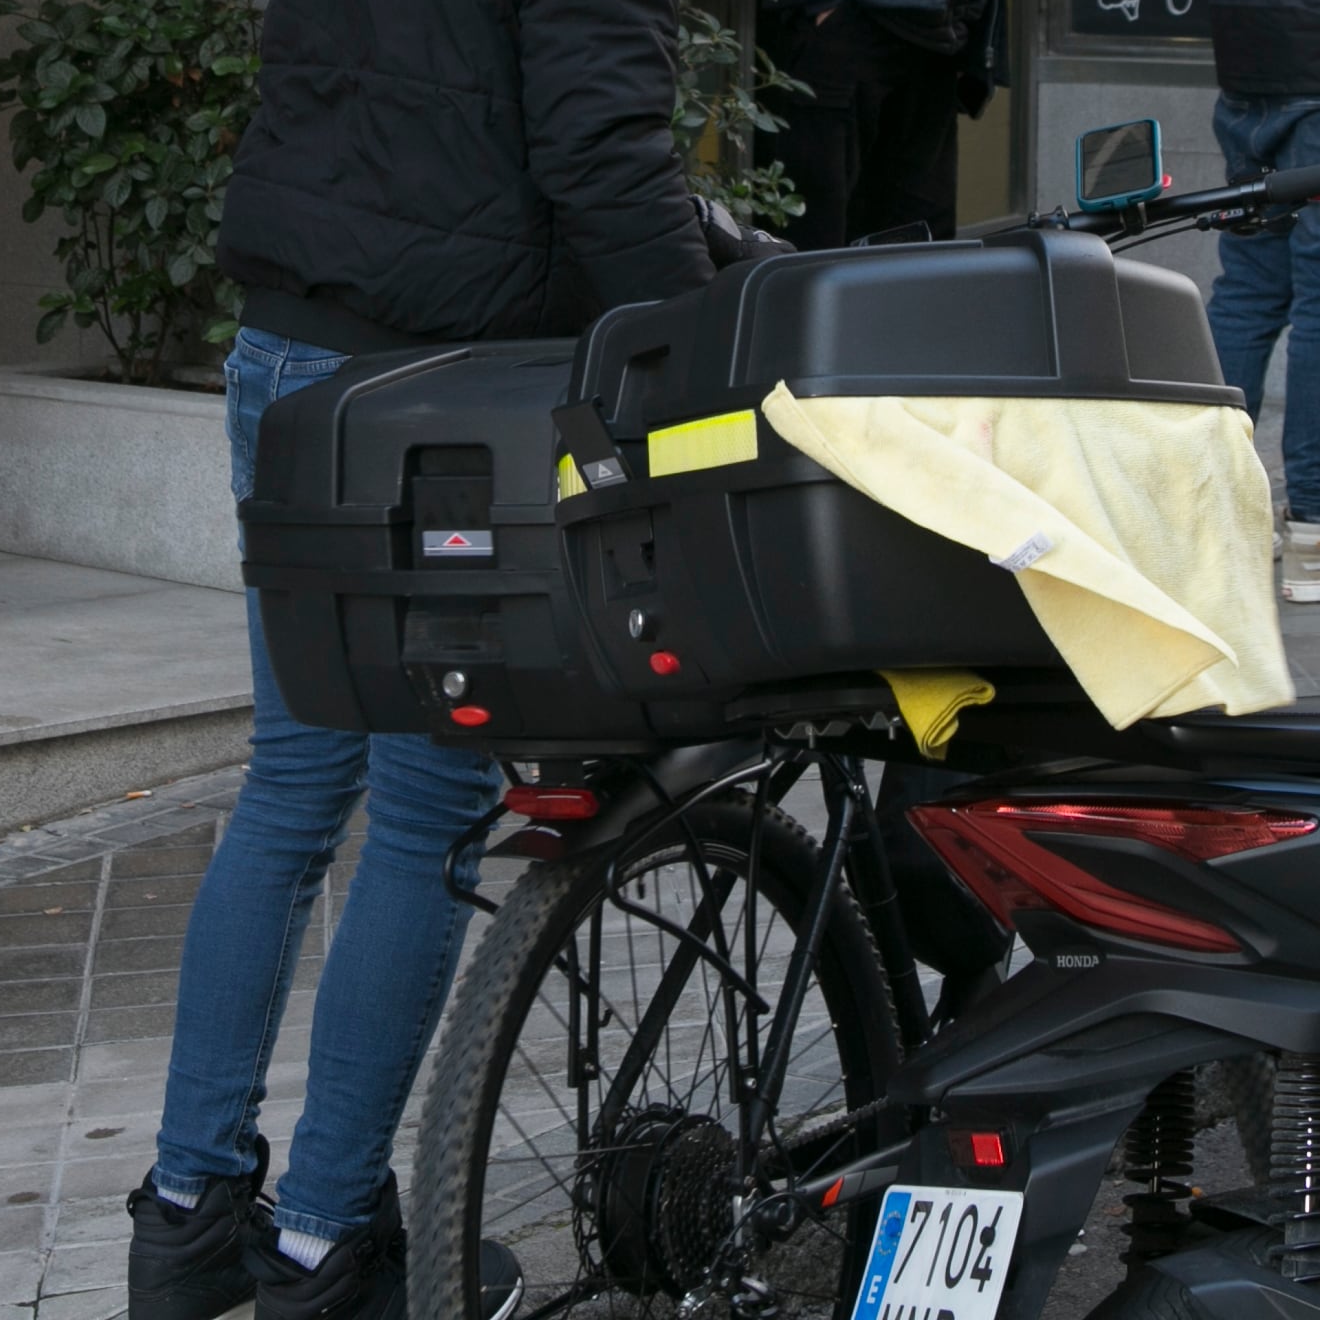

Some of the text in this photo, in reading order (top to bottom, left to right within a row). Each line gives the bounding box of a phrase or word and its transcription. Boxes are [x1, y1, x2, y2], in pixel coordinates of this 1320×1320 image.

[1056, 955, 1100, 968] HONDA
[893, 1200, 1003, 1293] 7104
[866, 1275, 883, 1304] E
